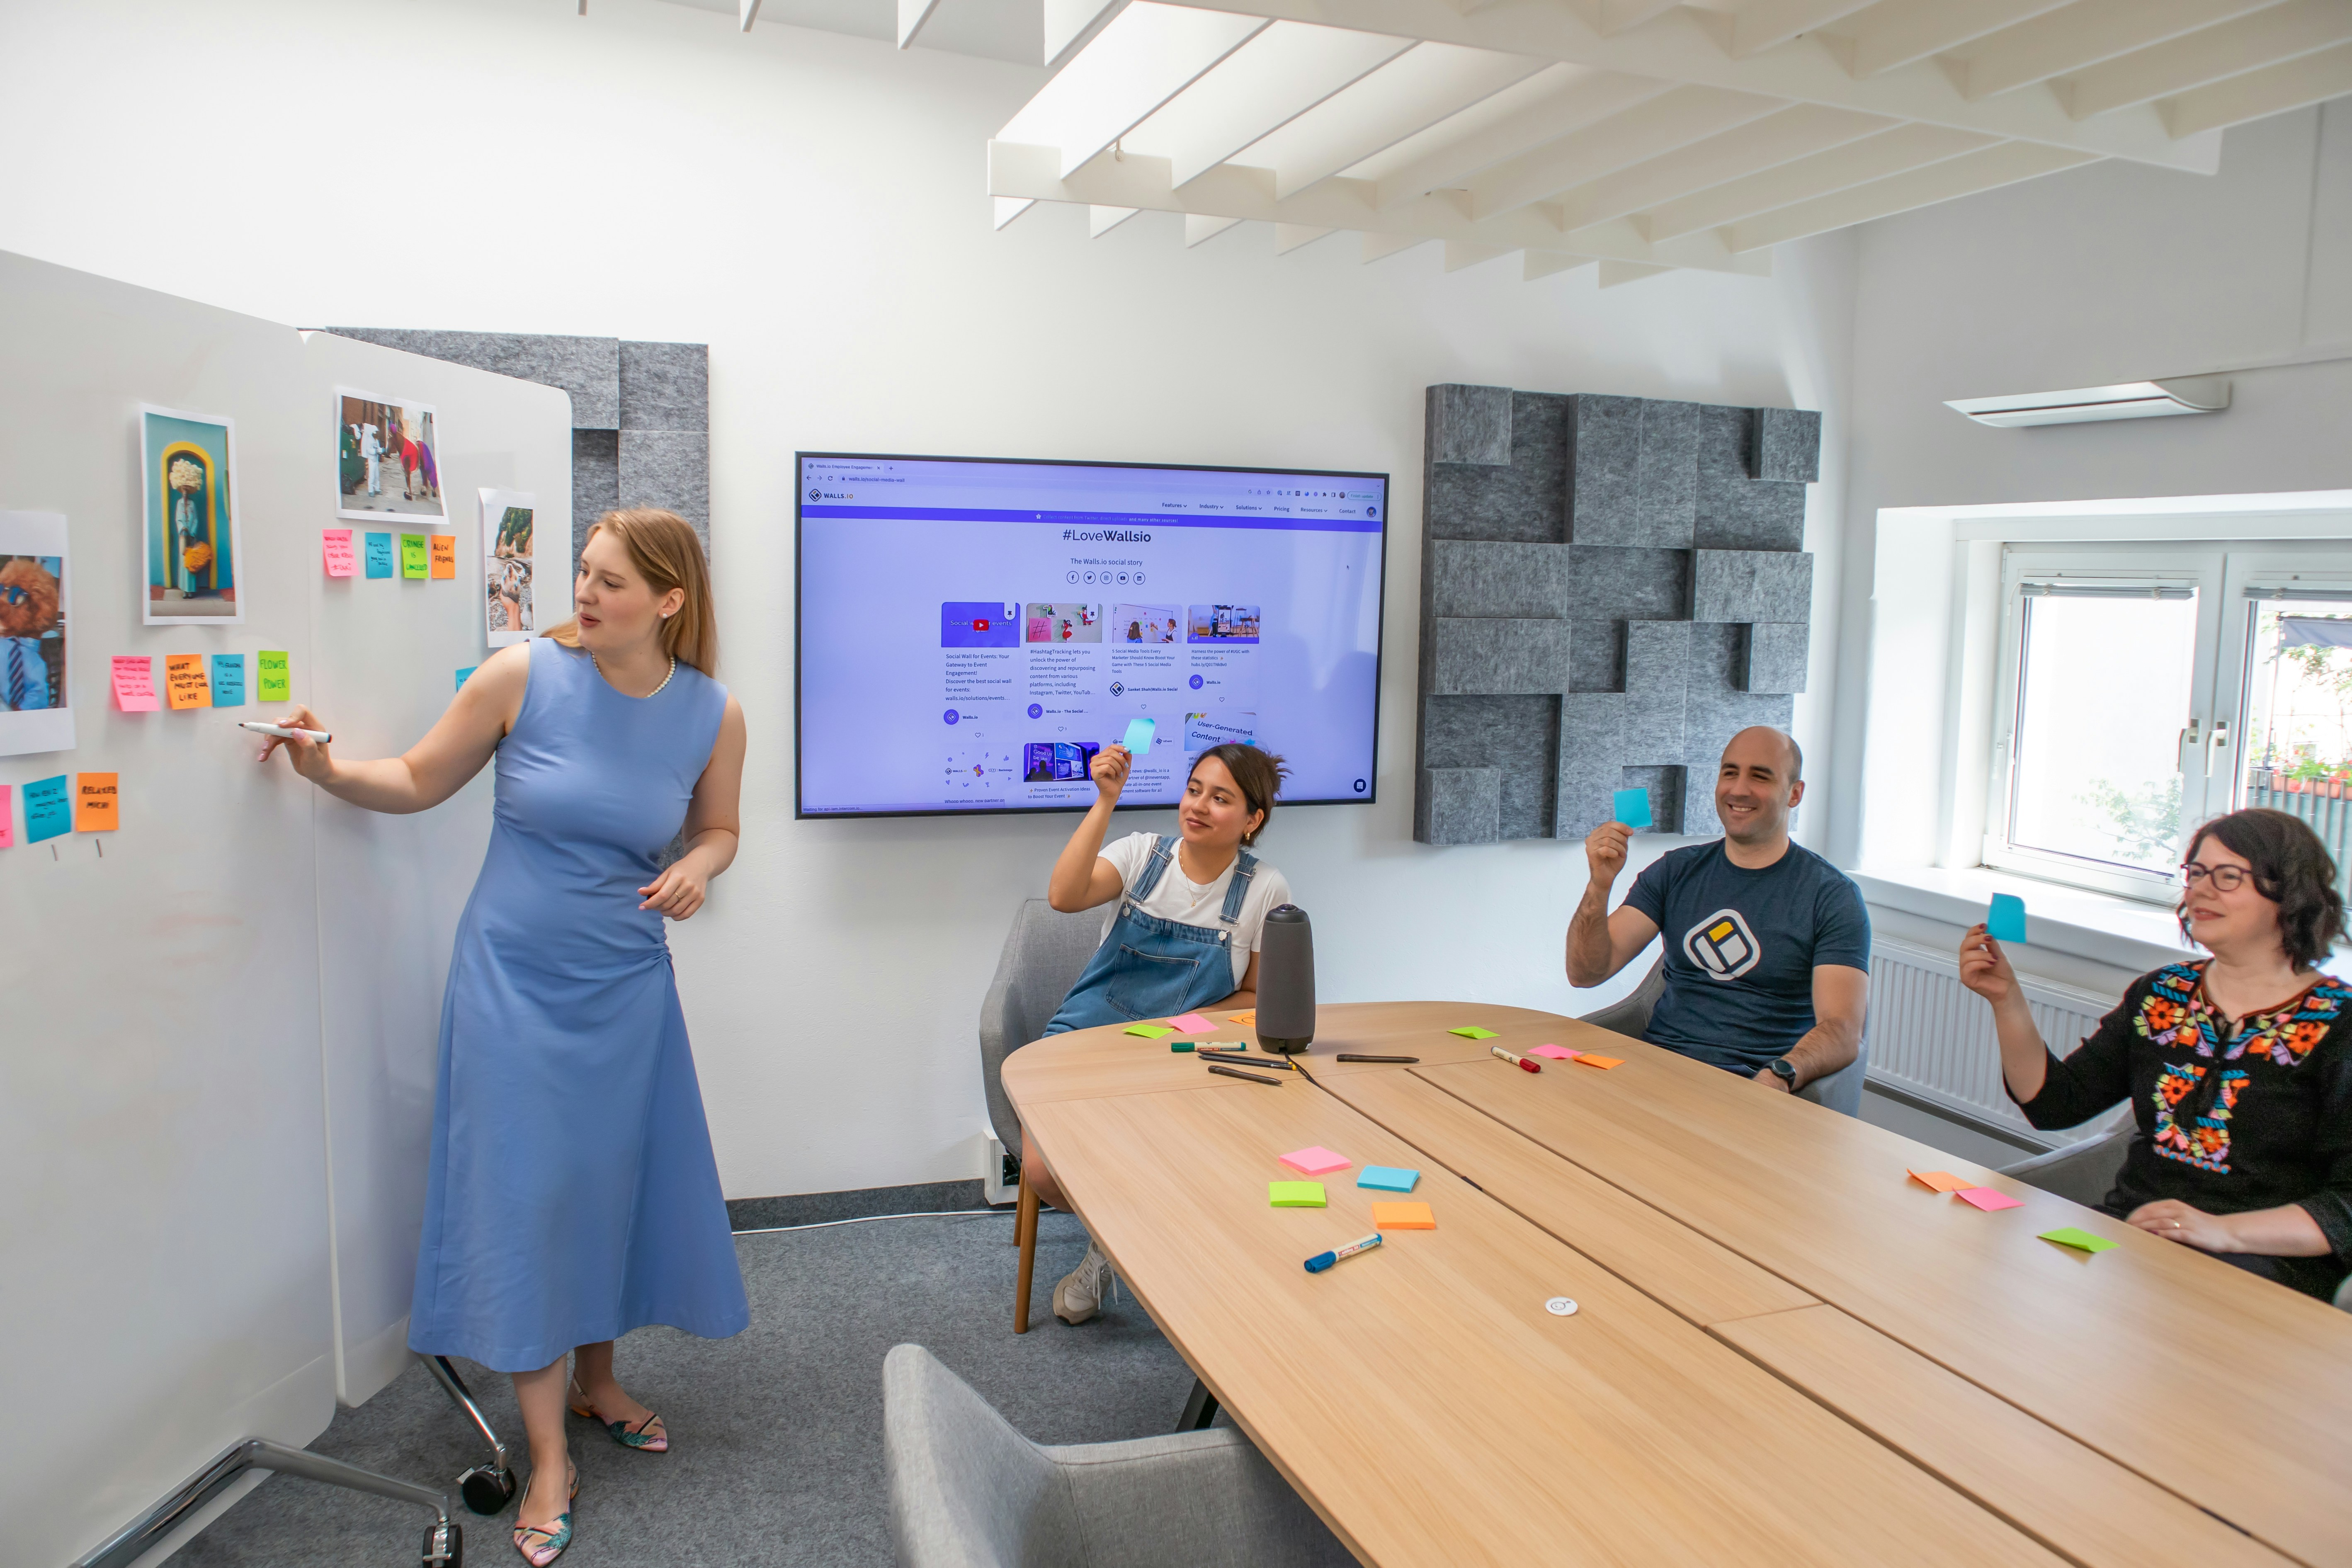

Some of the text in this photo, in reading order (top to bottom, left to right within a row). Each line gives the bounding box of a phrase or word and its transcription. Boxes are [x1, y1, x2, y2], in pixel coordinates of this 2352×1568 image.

[1063, 529, 1151, 542] #LoveWallsio
[403, 540, 423, 548] CRINGE
[169, 663, 190, 671] WHAT
[260, 659, 287, 669] FLOWER
[170, 672, 205, 681] EVERYONE
[264, 678, 286, 689] POWER
[1198, 721, 1252, 735] User-Generated
[1192, 732, 1220, 742] Content
